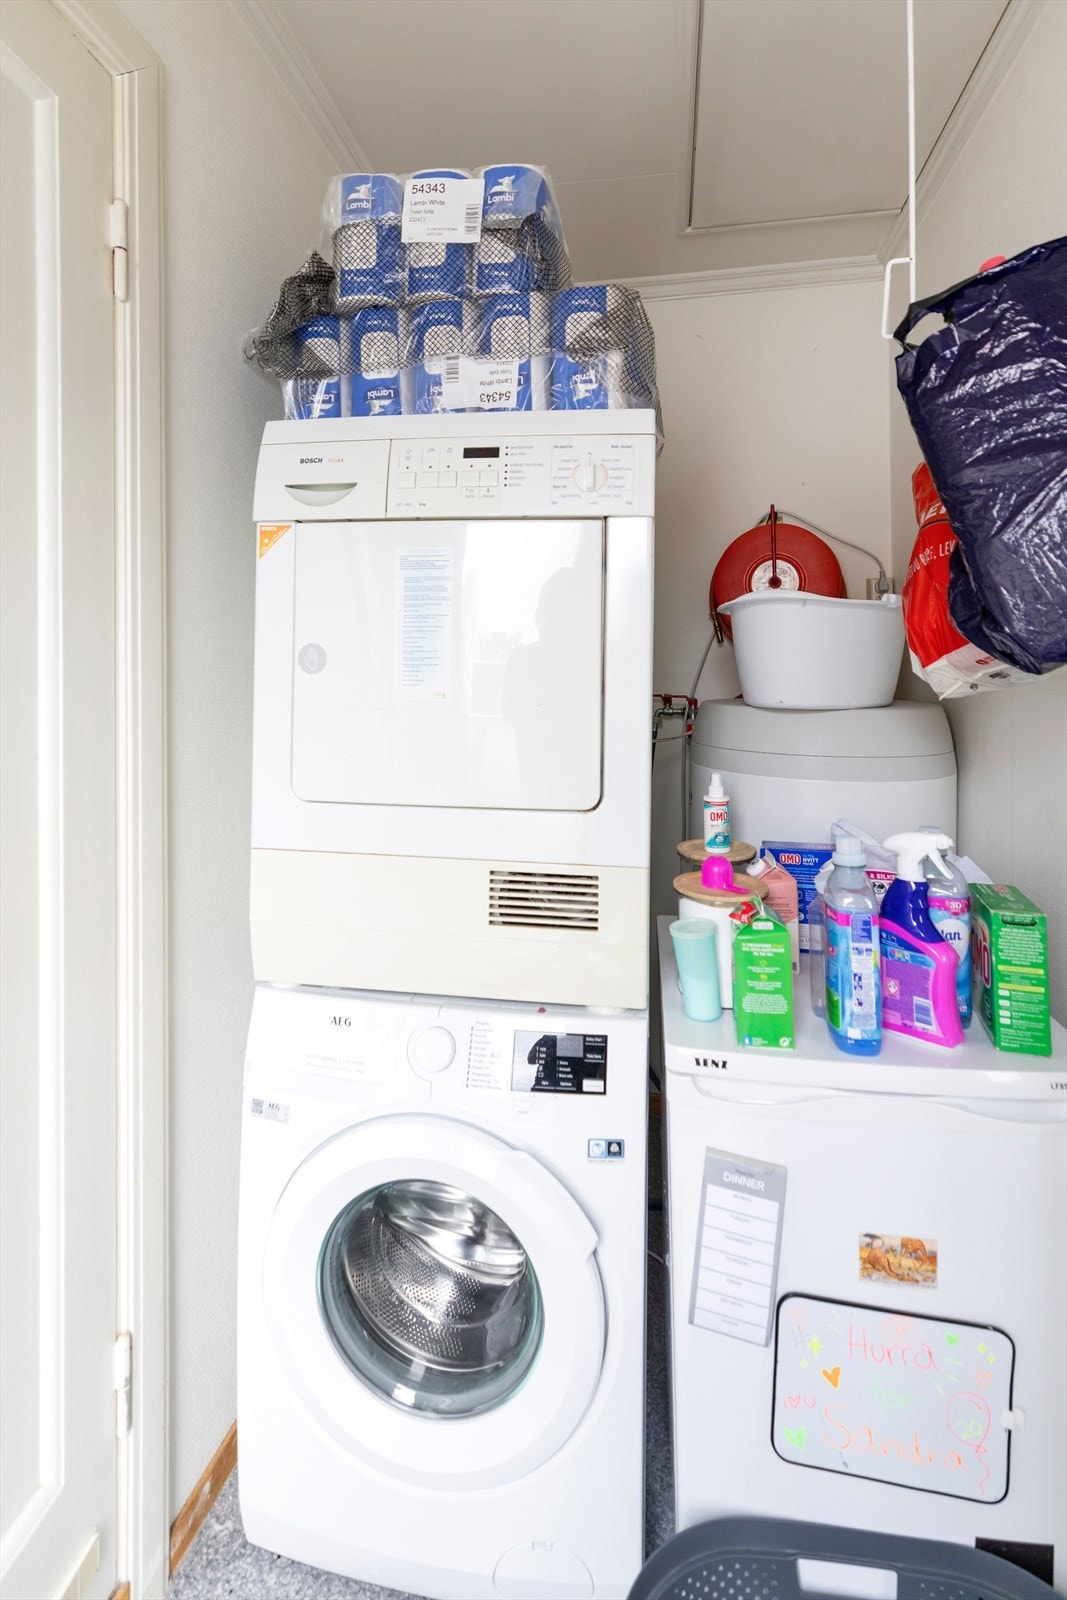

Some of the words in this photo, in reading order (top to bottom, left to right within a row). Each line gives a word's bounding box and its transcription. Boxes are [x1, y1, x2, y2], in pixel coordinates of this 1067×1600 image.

[411, 183, 446, 195] 54343
[487, 193, 515, 204] Lambi
[367, 388, 394, 400] Lambi
[479, 390, 512, 403] 54343
[710, 811, 728, 822] OMO
[780, 853, 801, 865] OMO
[949, 901, 962, 909] 3D
[330, 1015, 352, 1027] AEG
[269, 1102, 280, 1110] AEG
[723, 1171, 765, 1192] DINNER
[848, 1324, 939, 1371] Hurra
[957, 1419, 982, 1440] 20
[823, 1403, 968, 1472] Sandra
